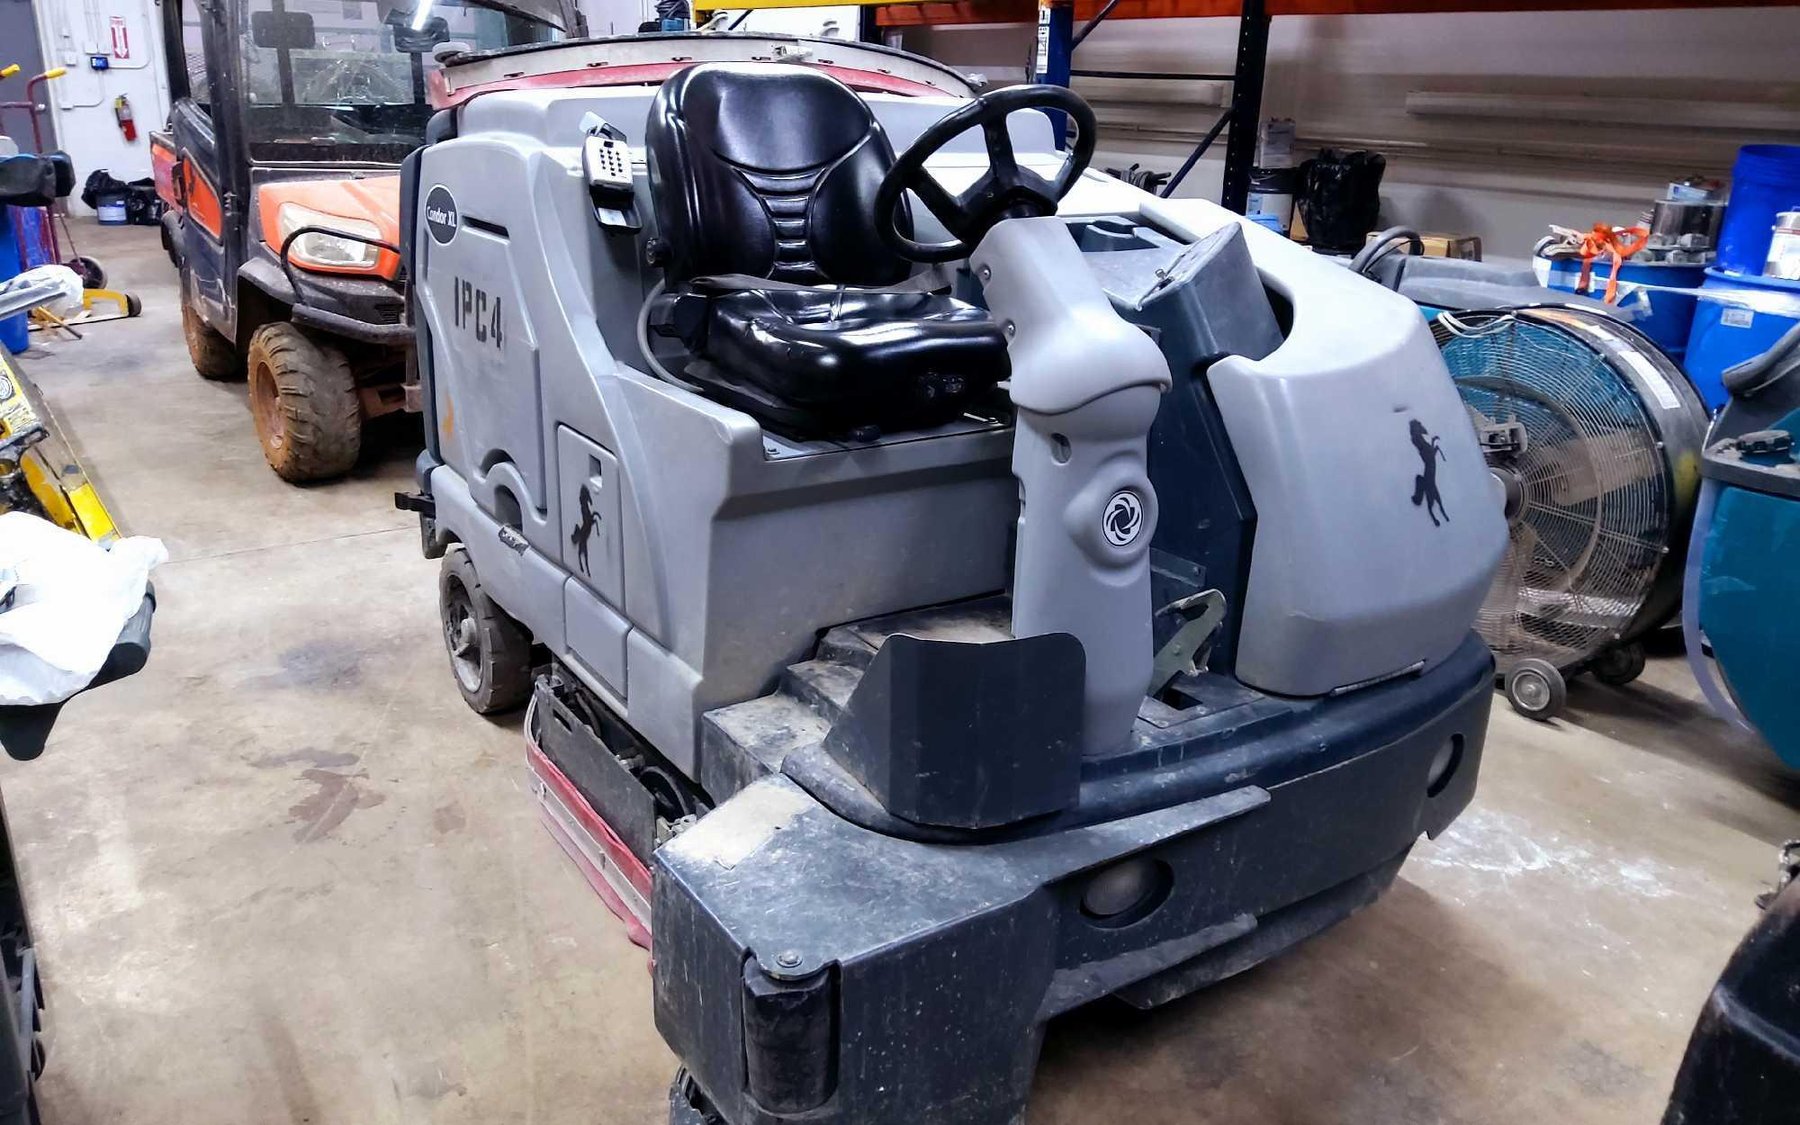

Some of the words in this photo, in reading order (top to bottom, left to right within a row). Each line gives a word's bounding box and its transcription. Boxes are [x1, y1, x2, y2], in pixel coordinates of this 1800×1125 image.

[426, 206, 447, 225] Condor
[447, 210, 456, 227] XL
[455, 276, 502, 350] IPC4
